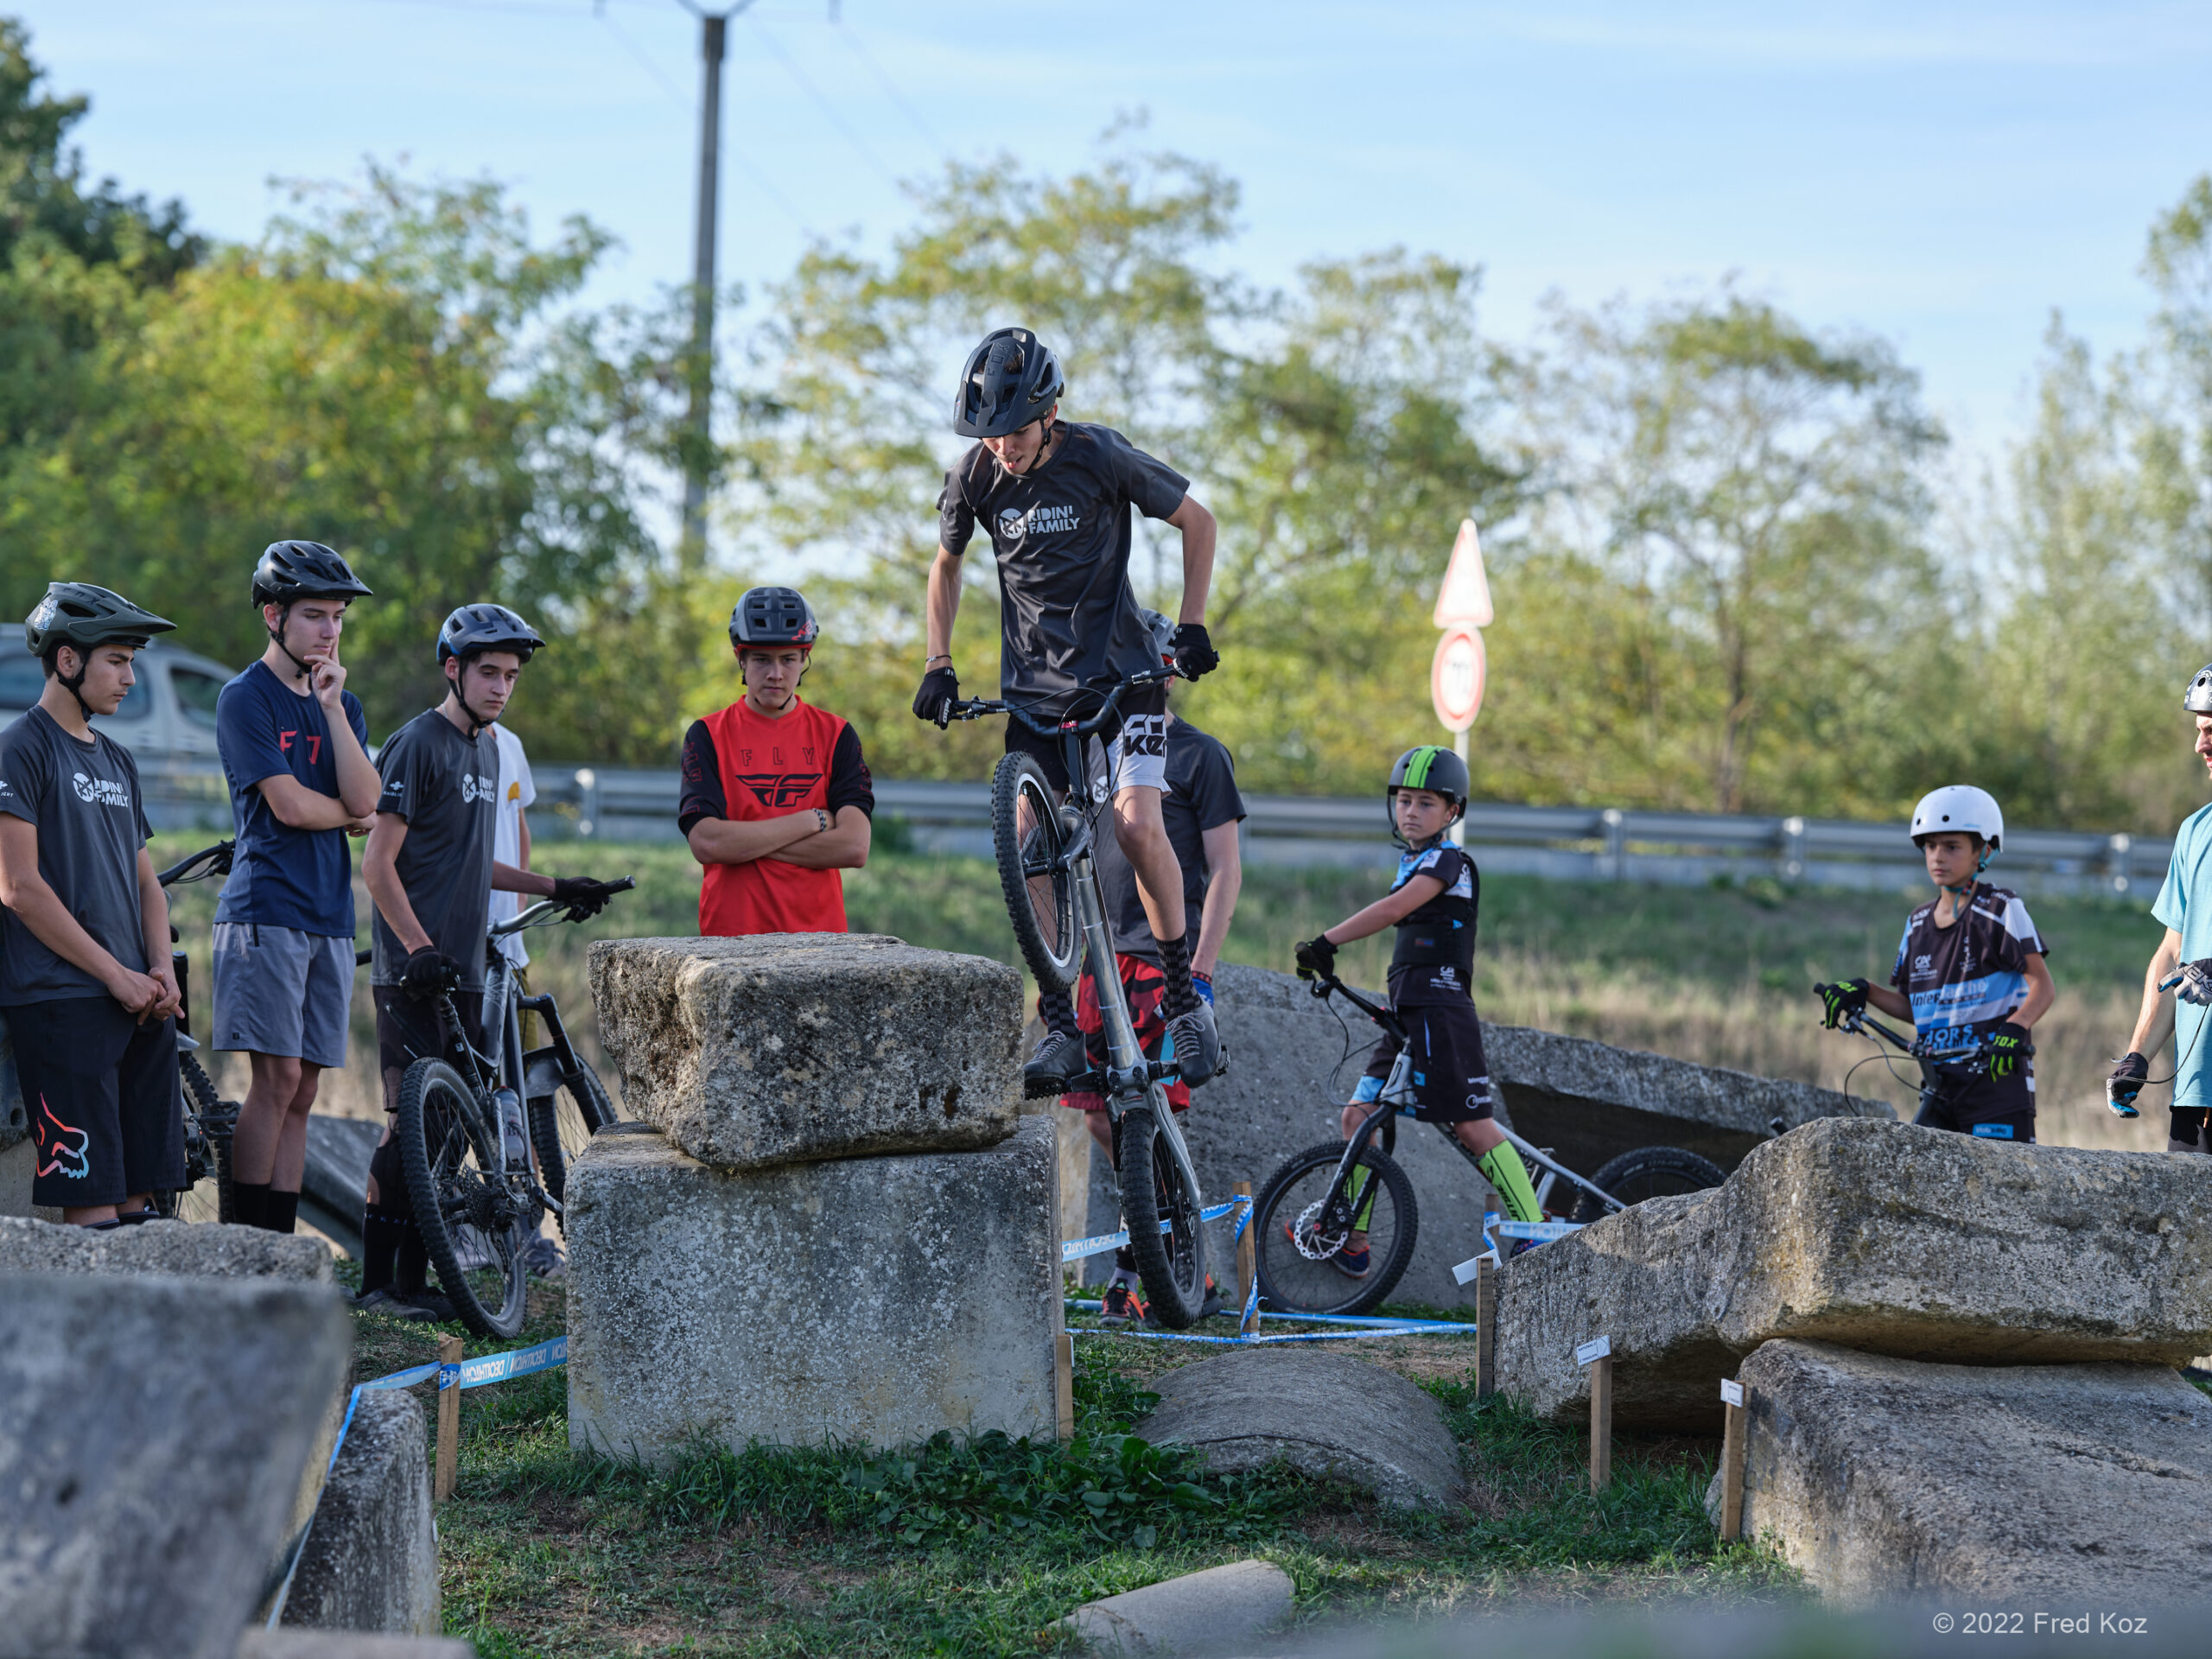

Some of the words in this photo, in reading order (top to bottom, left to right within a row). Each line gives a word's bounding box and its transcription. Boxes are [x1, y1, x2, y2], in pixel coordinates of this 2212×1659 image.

[1027, 505, 1073, 522] RIDIN'
[1027, 518, 1080, 534] FAMILY
[741, 747, 815, 767] FLY
